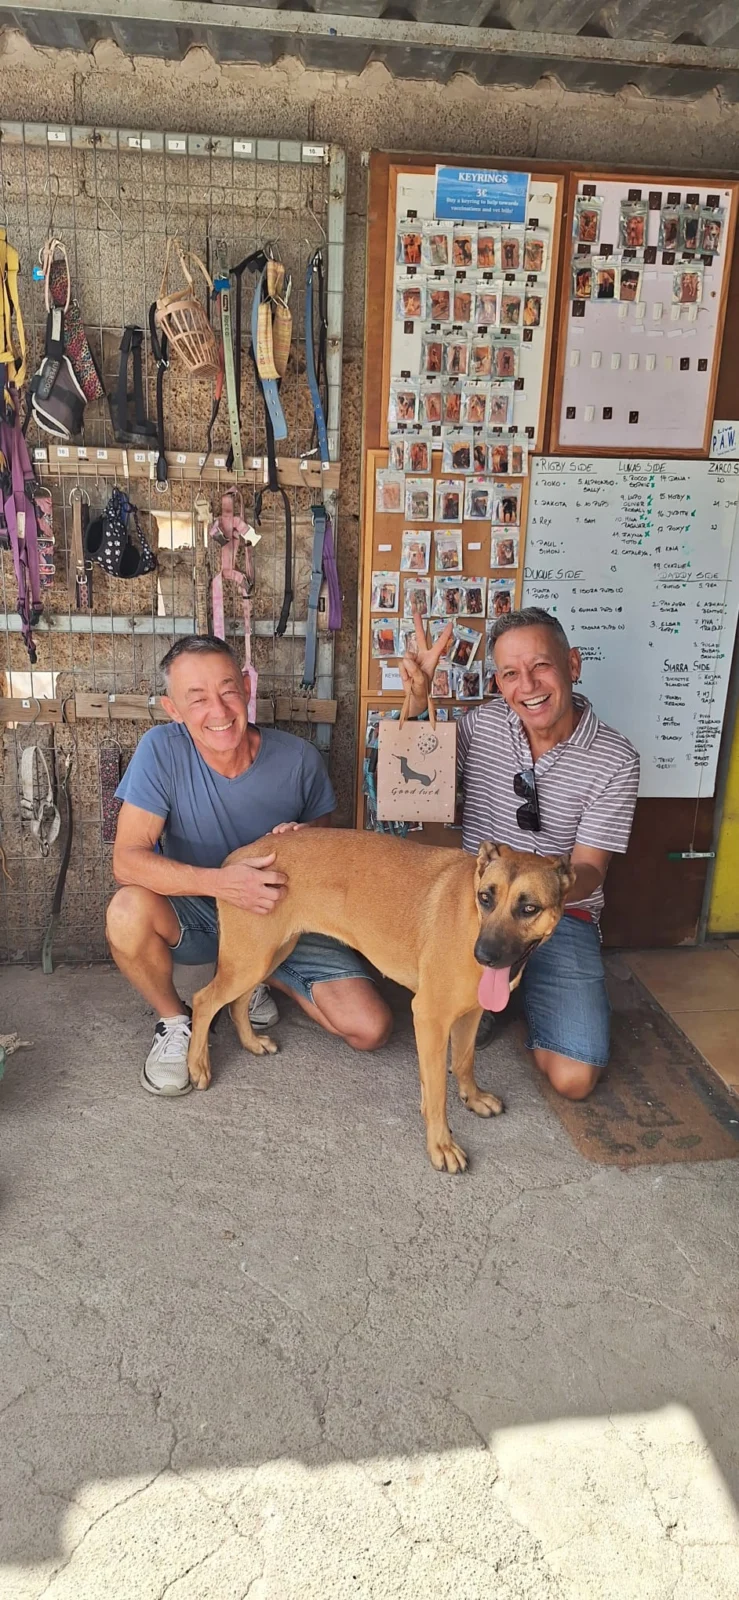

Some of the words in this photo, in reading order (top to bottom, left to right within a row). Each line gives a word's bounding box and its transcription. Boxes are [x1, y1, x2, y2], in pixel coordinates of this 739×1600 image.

[458, 172, 509, 184] KEYRINGS
[476, 188, 488, 197] 3€
[461, 198, 480, 206] keyring
[44, 360, 60, 393] SUPERDOG
[541, 459, 566, 473] RIGBY
[570, 463, 594, 473] SIDE
[645, 462, 667, 473] SIDE
[708, 463, 732, 474] ZARCO
[524, 567, 554, 580] DUQUE
[555, 568, 584, 580] SIDE
[658, 572, 693, 582] DADDY
[693, 660, 711, 672] SIDE
[391, 787, 417, 796] Good
[419, 788, 440, 796] luck
